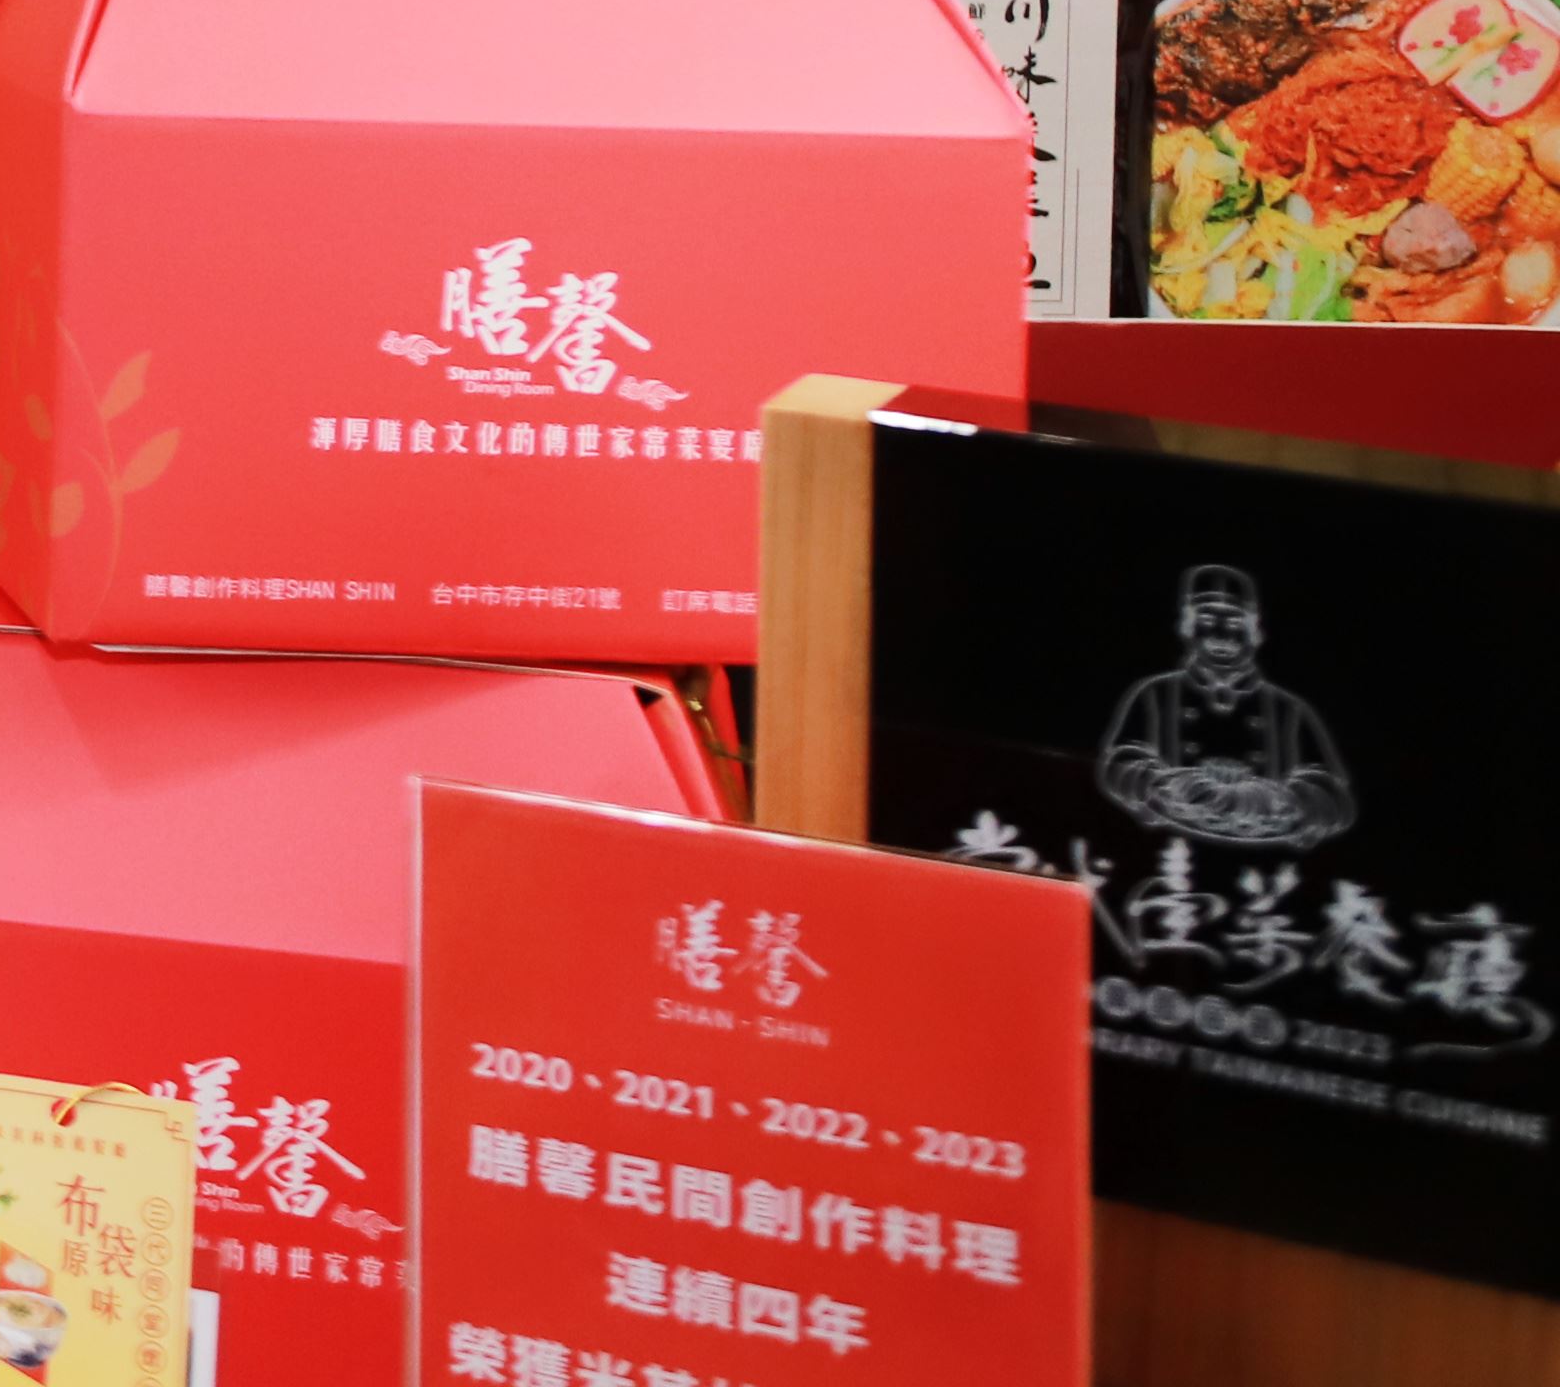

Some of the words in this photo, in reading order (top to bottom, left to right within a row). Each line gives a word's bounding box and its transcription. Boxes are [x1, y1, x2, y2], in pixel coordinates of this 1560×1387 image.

[441, 236, 652, 395] 膳馨
[446, 366, 491, 381] Shan
[494, 366, 532, 382] Shin
[344, 579, 397, 602] SHIN
[657, 898, 829, 1008] 膳馨
[654, 996, 733, 1030] SHAN
[758, 1013, 830, 1048] SHIN
[468, 1123, 1022, 1287] 膳馨民間創作料理
[607, 1250, 871, 1359] 連續四年
